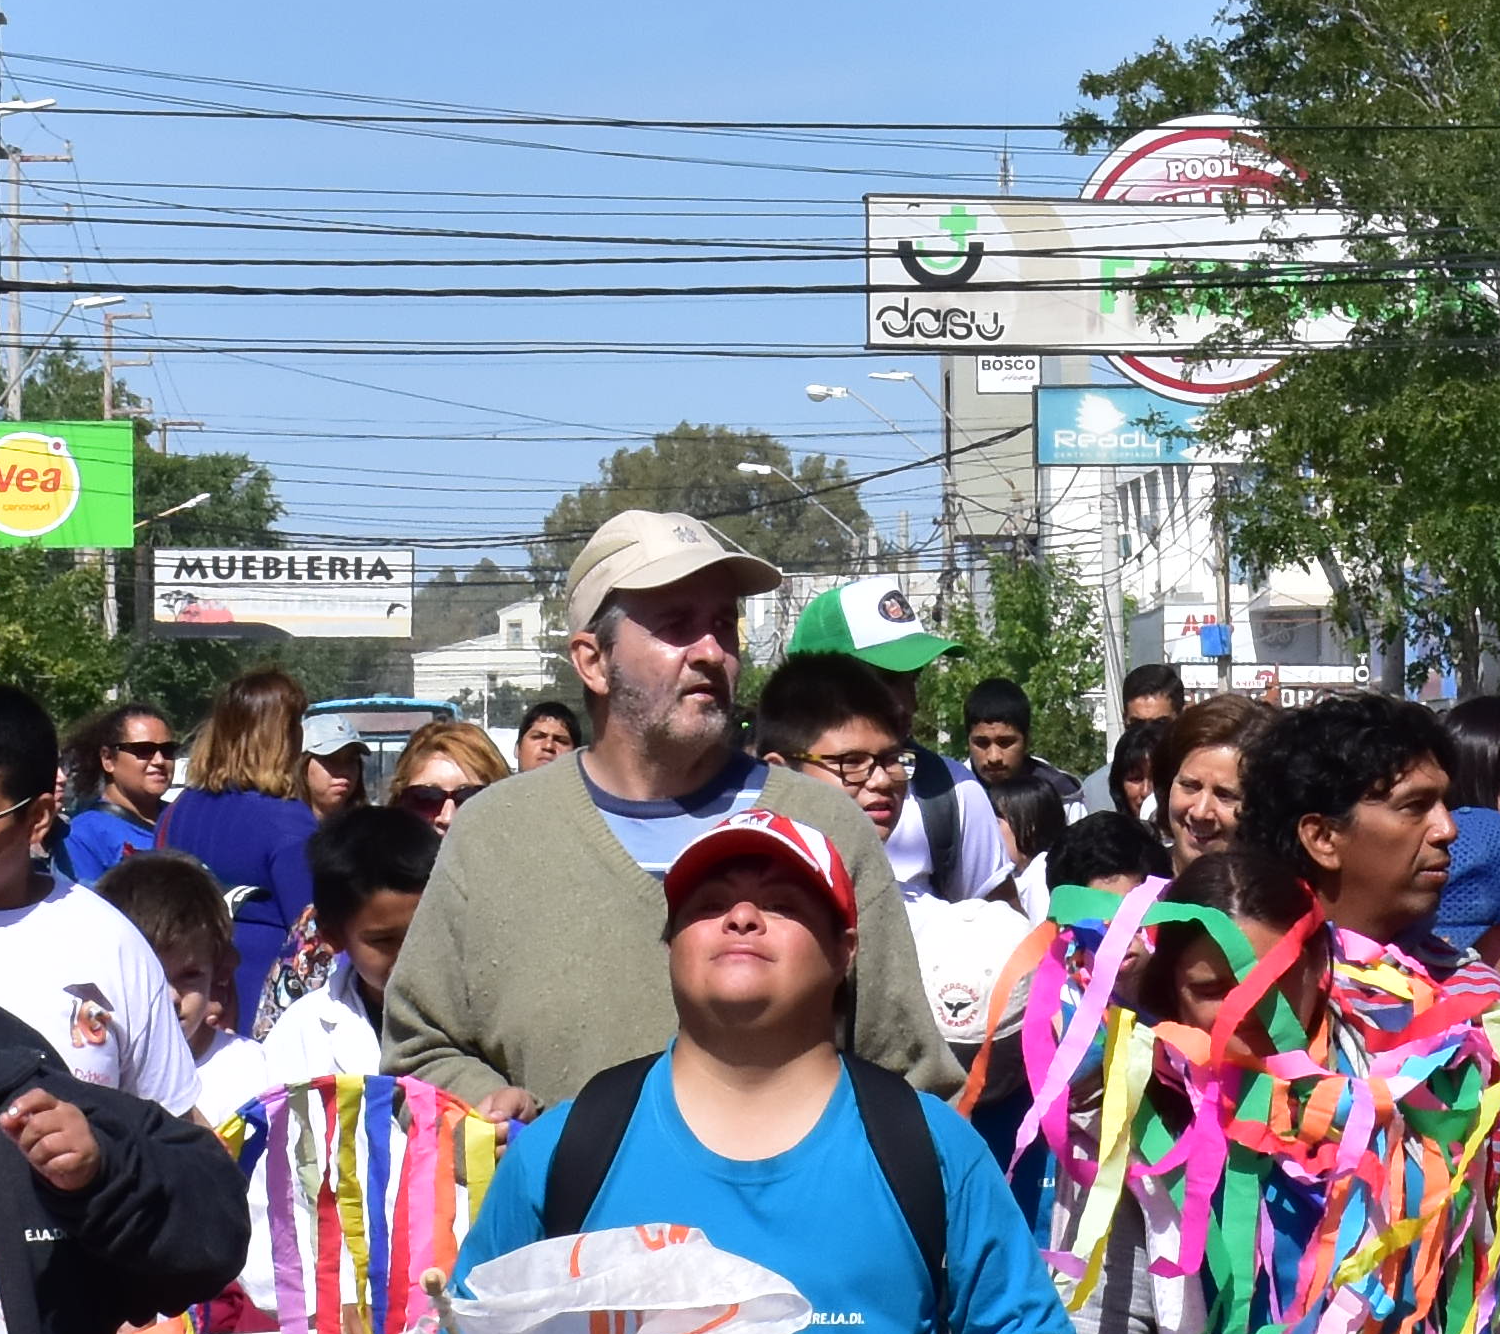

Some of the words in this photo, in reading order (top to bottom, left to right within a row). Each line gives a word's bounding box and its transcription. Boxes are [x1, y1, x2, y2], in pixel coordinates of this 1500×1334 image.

[1167, 158, 1240, 181] POOL
[876, 297, 1005, 341] dasu
[981, 359, 1036, 371] BOSCO
[1054, 430, 1161, 457] Ready
[173, 555, 394, 581] MUEBLERIA
[811, 1312, 865, 1325] RE.LA.DI.
